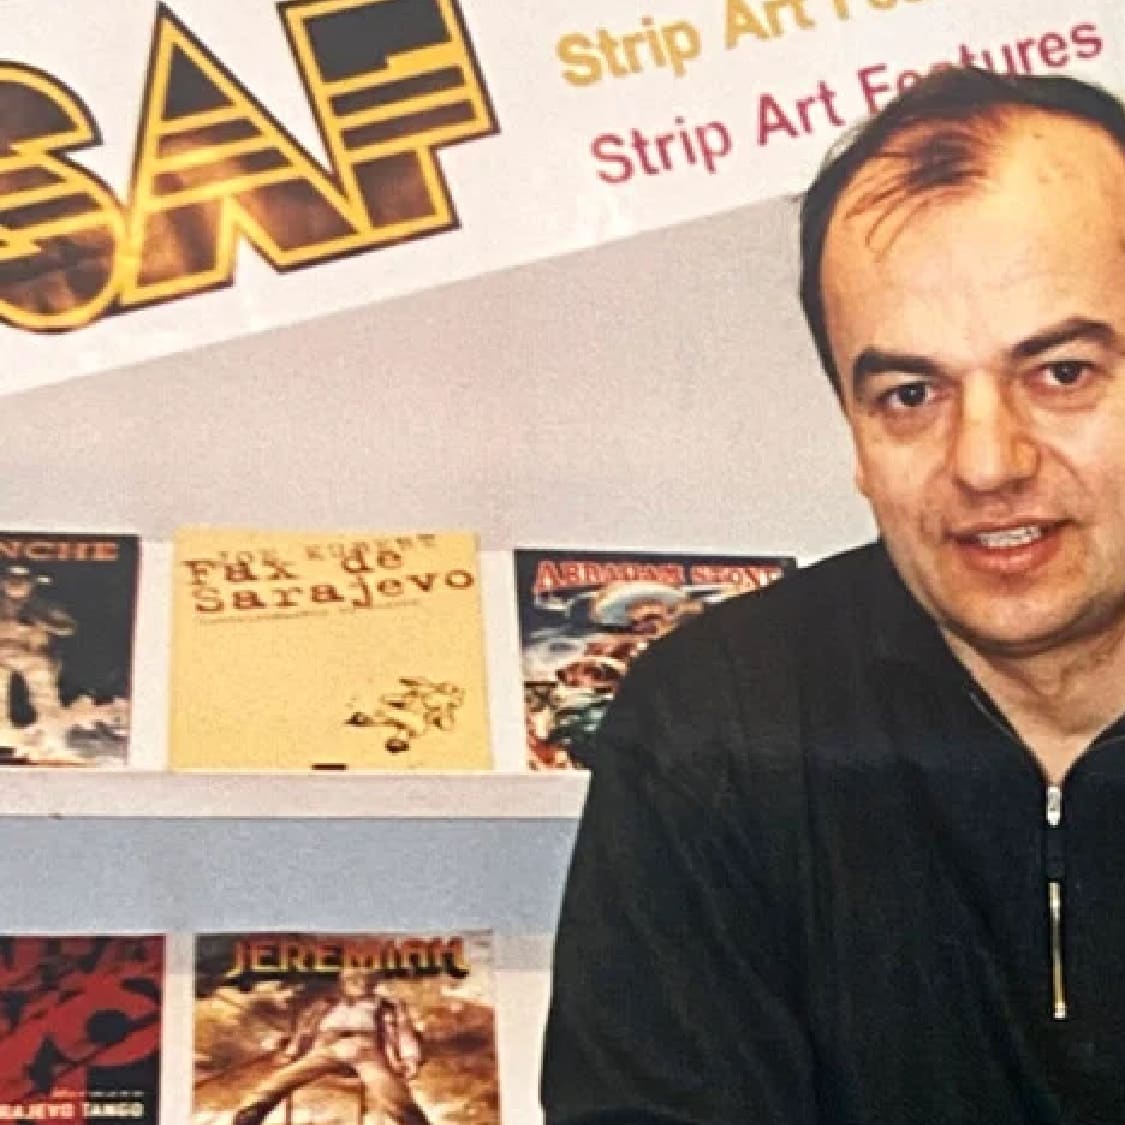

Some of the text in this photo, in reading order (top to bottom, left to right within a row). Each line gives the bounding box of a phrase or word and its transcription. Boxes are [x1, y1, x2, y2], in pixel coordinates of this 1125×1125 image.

[556, 14, 702, 86] Strip
[590, 22, 1104, 184] Strip Art Fetures
[181, 547, 405, 586] Fax de
[191, 568, 476, 614] Sarajevo
[225, 936, 471, 978] JEREMIAH
